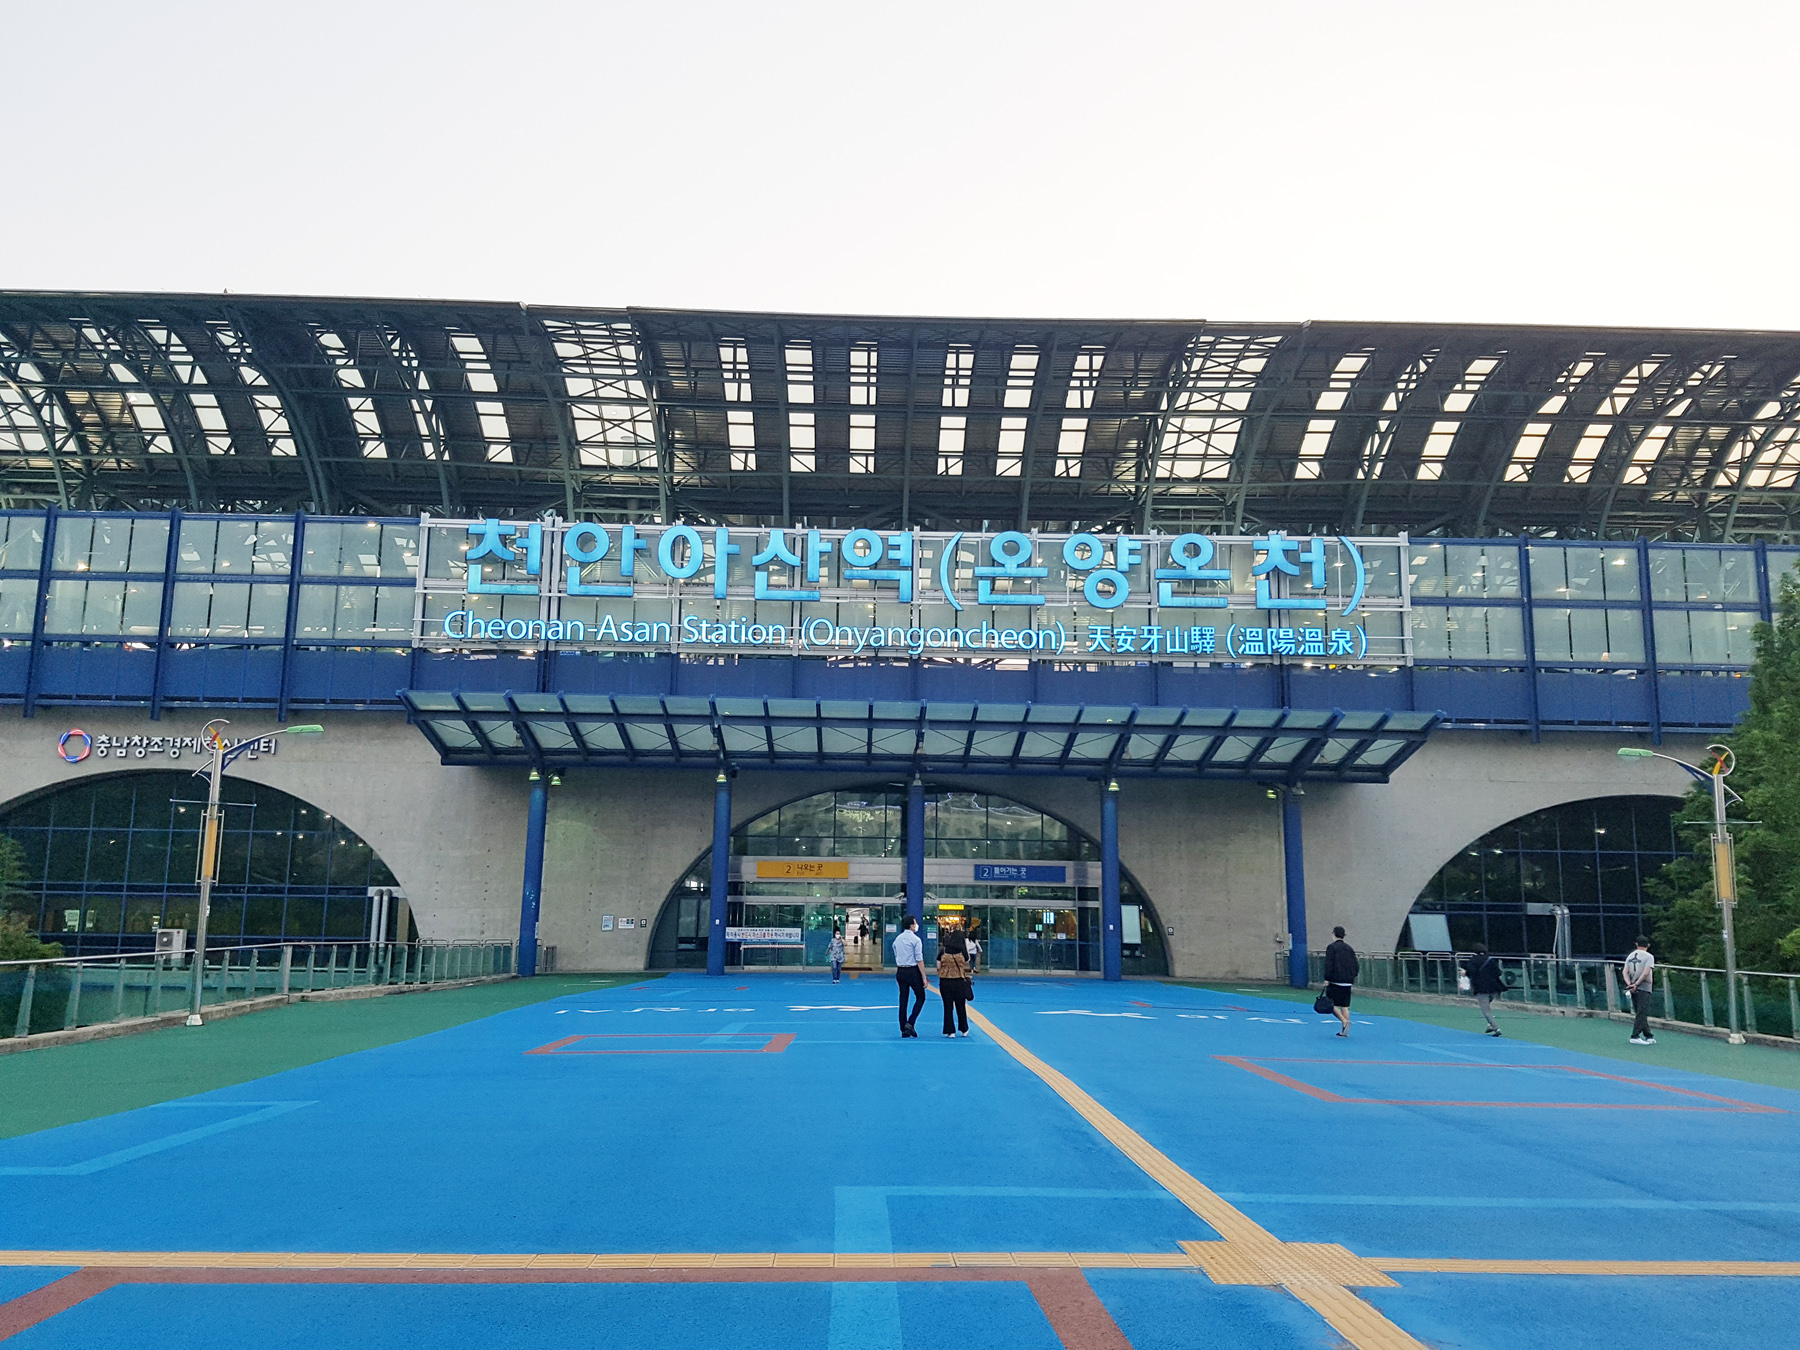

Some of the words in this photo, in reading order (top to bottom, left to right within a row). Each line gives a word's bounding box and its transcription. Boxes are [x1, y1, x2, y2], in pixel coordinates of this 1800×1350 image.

[443, 610, 671, 644] Cheonan-Asan
[682, 615, 786, 645] Station
[801, 615, 1066, 655] (Onyangoncheon)
[797, 863, 815, 871] 나오는
